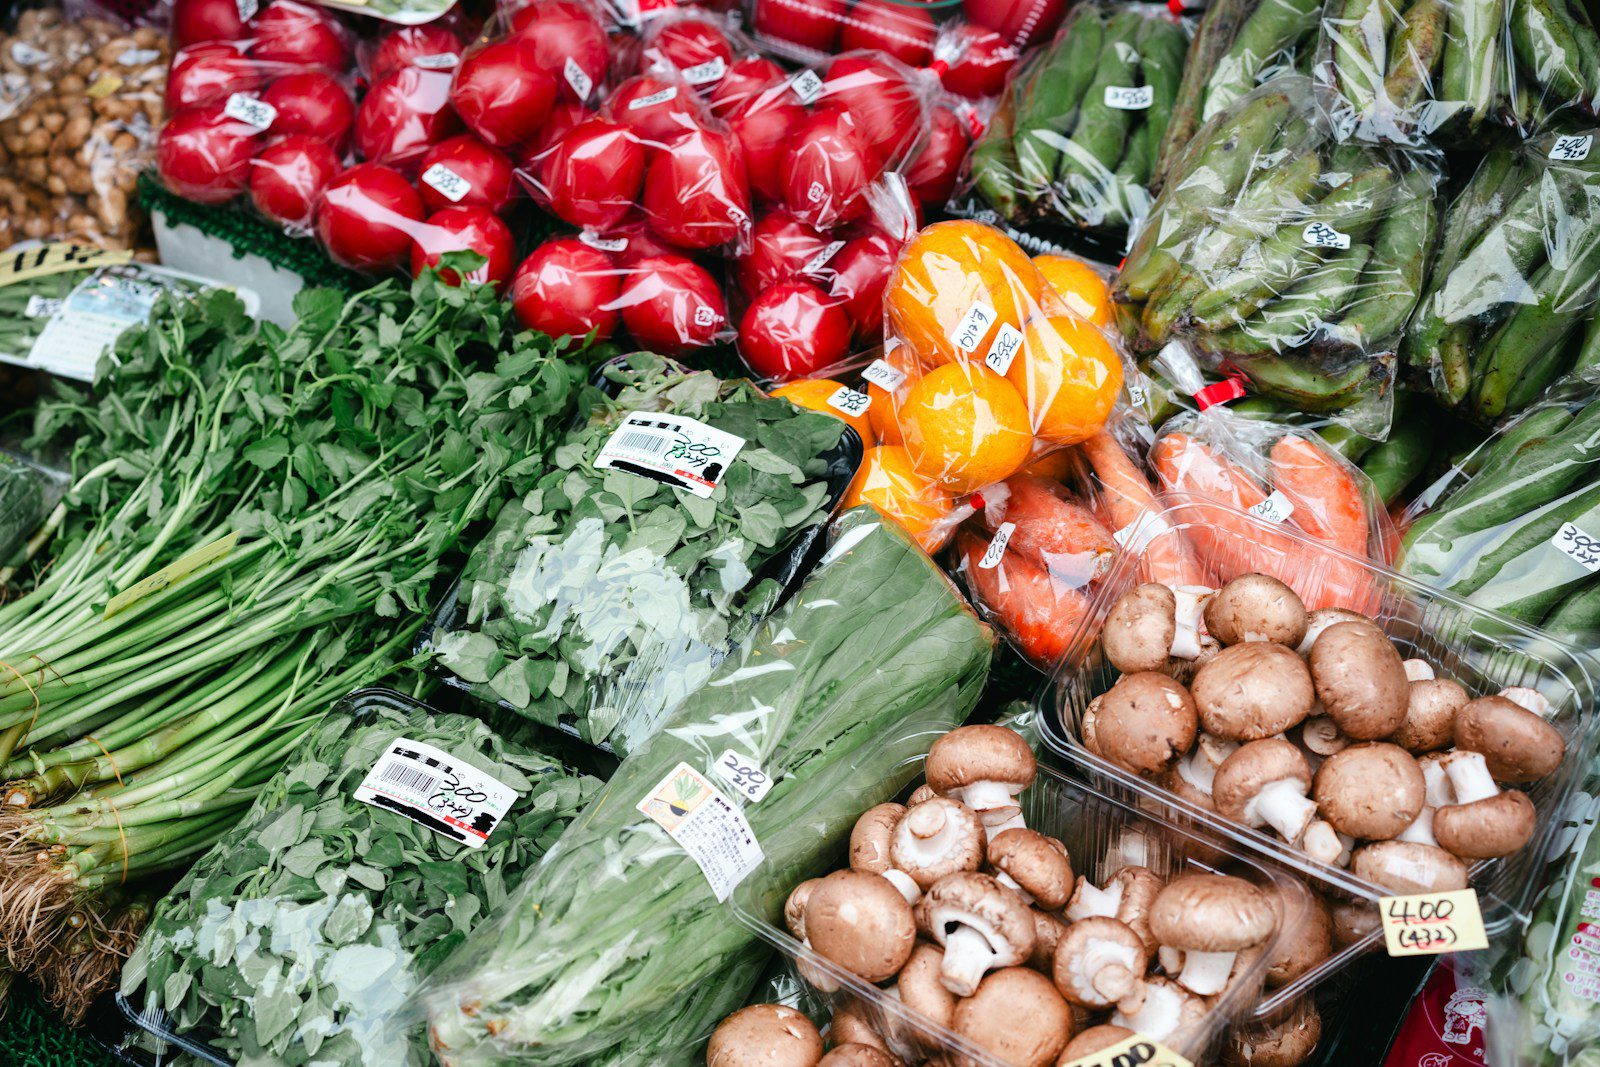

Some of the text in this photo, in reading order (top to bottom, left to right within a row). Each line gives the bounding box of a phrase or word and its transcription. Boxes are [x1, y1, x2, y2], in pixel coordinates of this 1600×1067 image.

[1555, 136, 1588, 151] 300
[1307, 222, 1338, 241] 300
[724, 754, 767, 785] 200
[439, 773, 488, 803] 300
[733, 774, 760, 795] 216
[1389, 900, 1454, 926] 400
[1399, 926, 1457, 948] (432)
